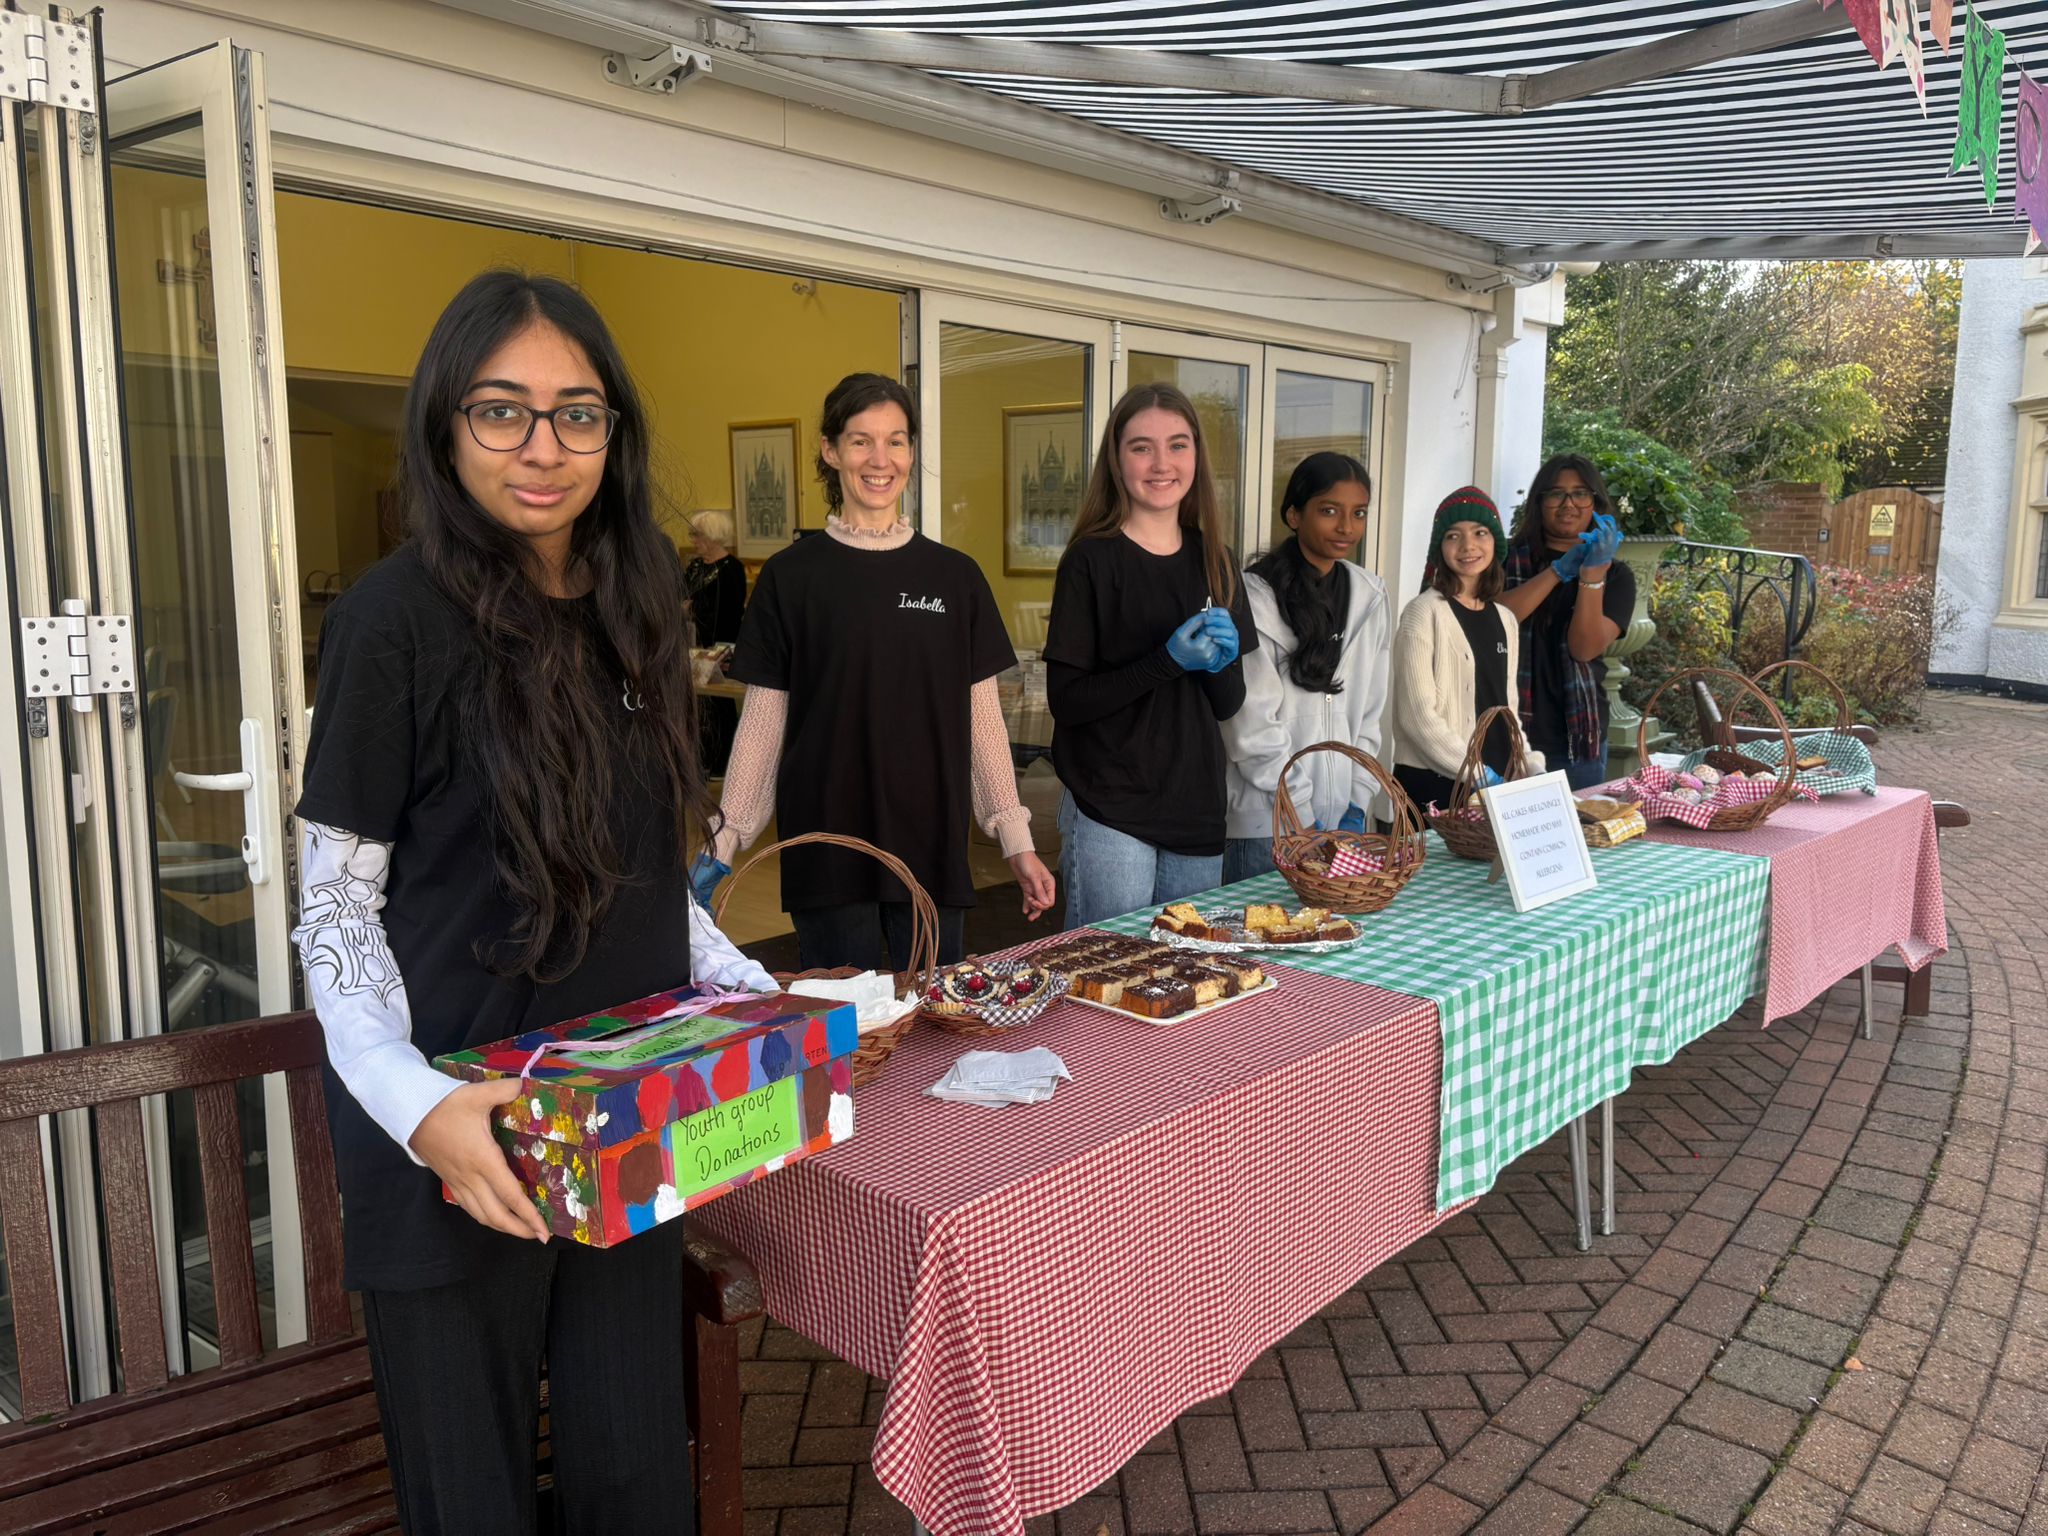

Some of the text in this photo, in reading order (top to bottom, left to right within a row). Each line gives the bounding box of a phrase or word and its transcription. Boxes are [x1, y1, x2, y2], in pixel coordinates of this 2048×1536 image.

[898, 592, 946, 613] Isabella
[679, 1084, 775, 1146] Youth group
[695, 1122, 781, 1182] Donations
